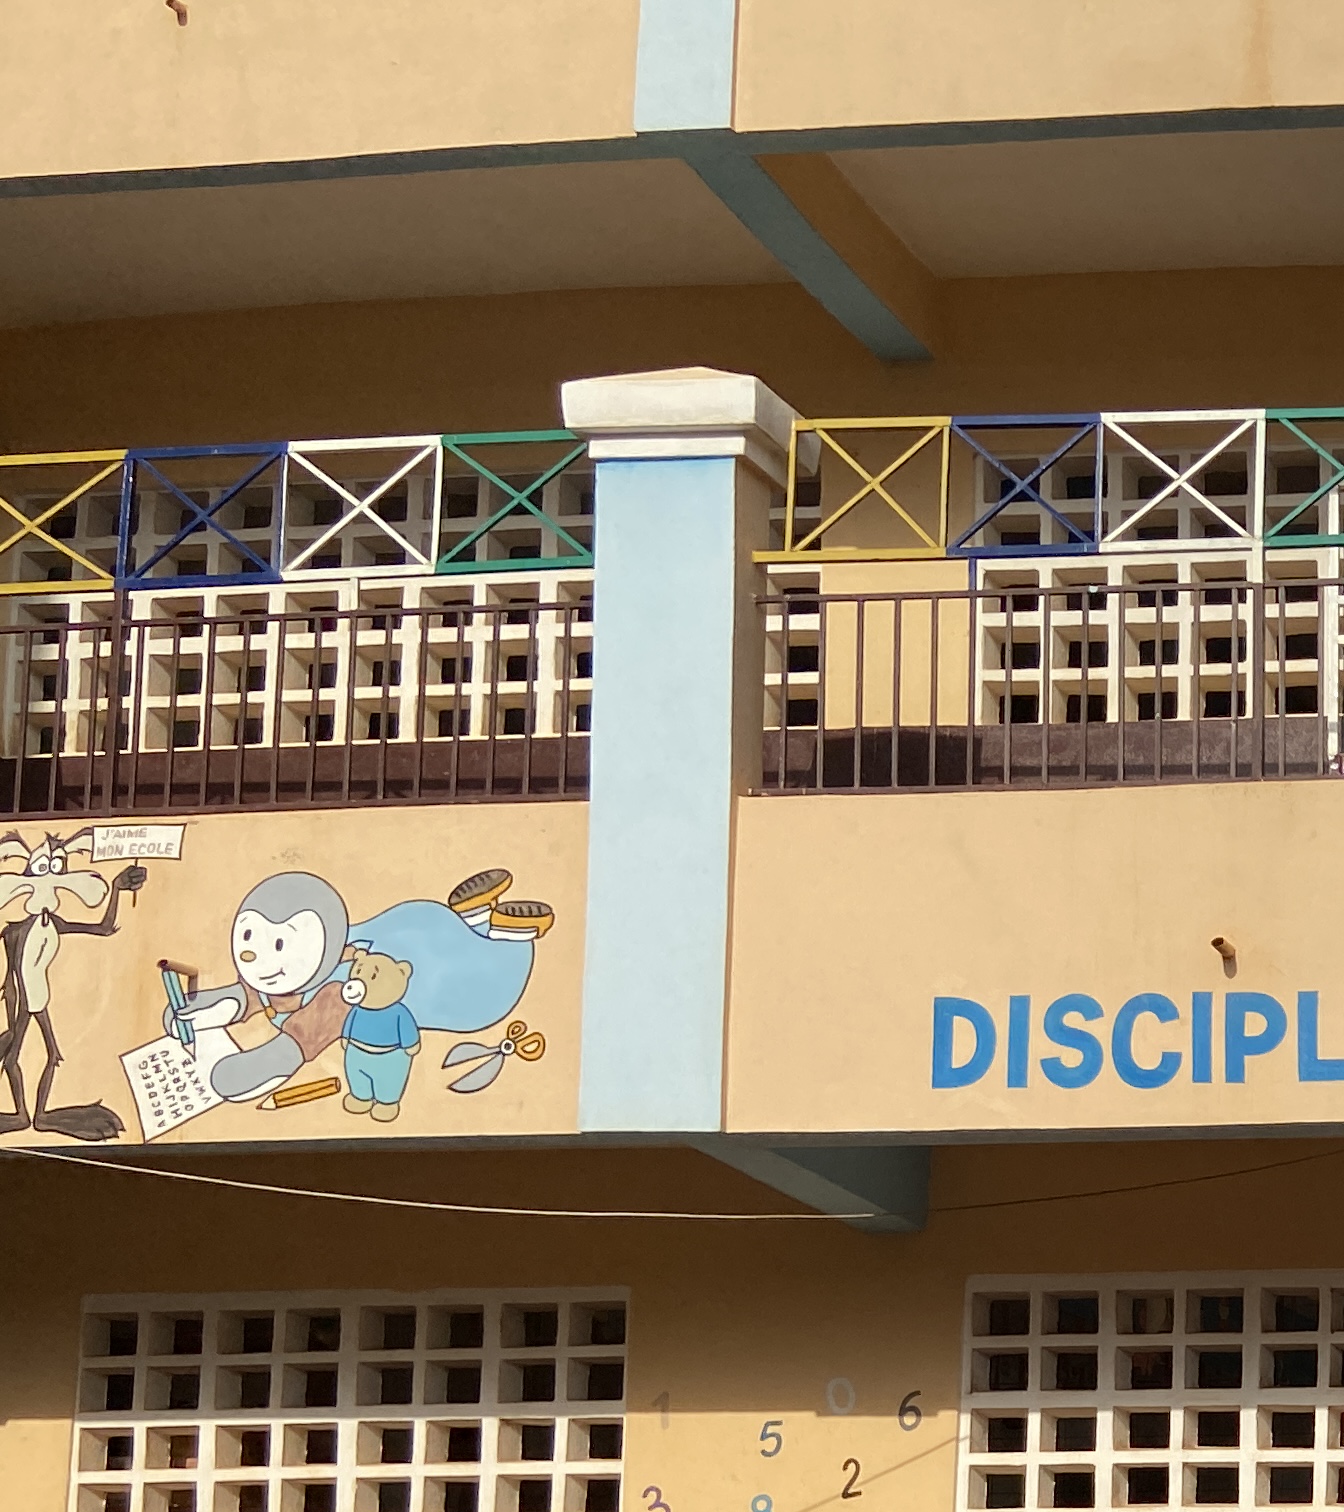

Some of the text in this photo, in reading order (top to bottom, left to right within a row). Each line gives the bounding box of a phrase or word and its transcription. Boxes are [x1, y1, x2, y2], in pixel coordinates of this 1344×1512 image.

[96, 842, 175, 858] MON ECOLE
[101, 827, 148, 841] J'AIME
[650, 1390, 671, 1431] 1
[826, 1377, 856, 1416] 0
[898, 1390, 922, 1431] 6
[759, 1419, 784, 1458] 5
[841, 1458, 863, 1500] 2
